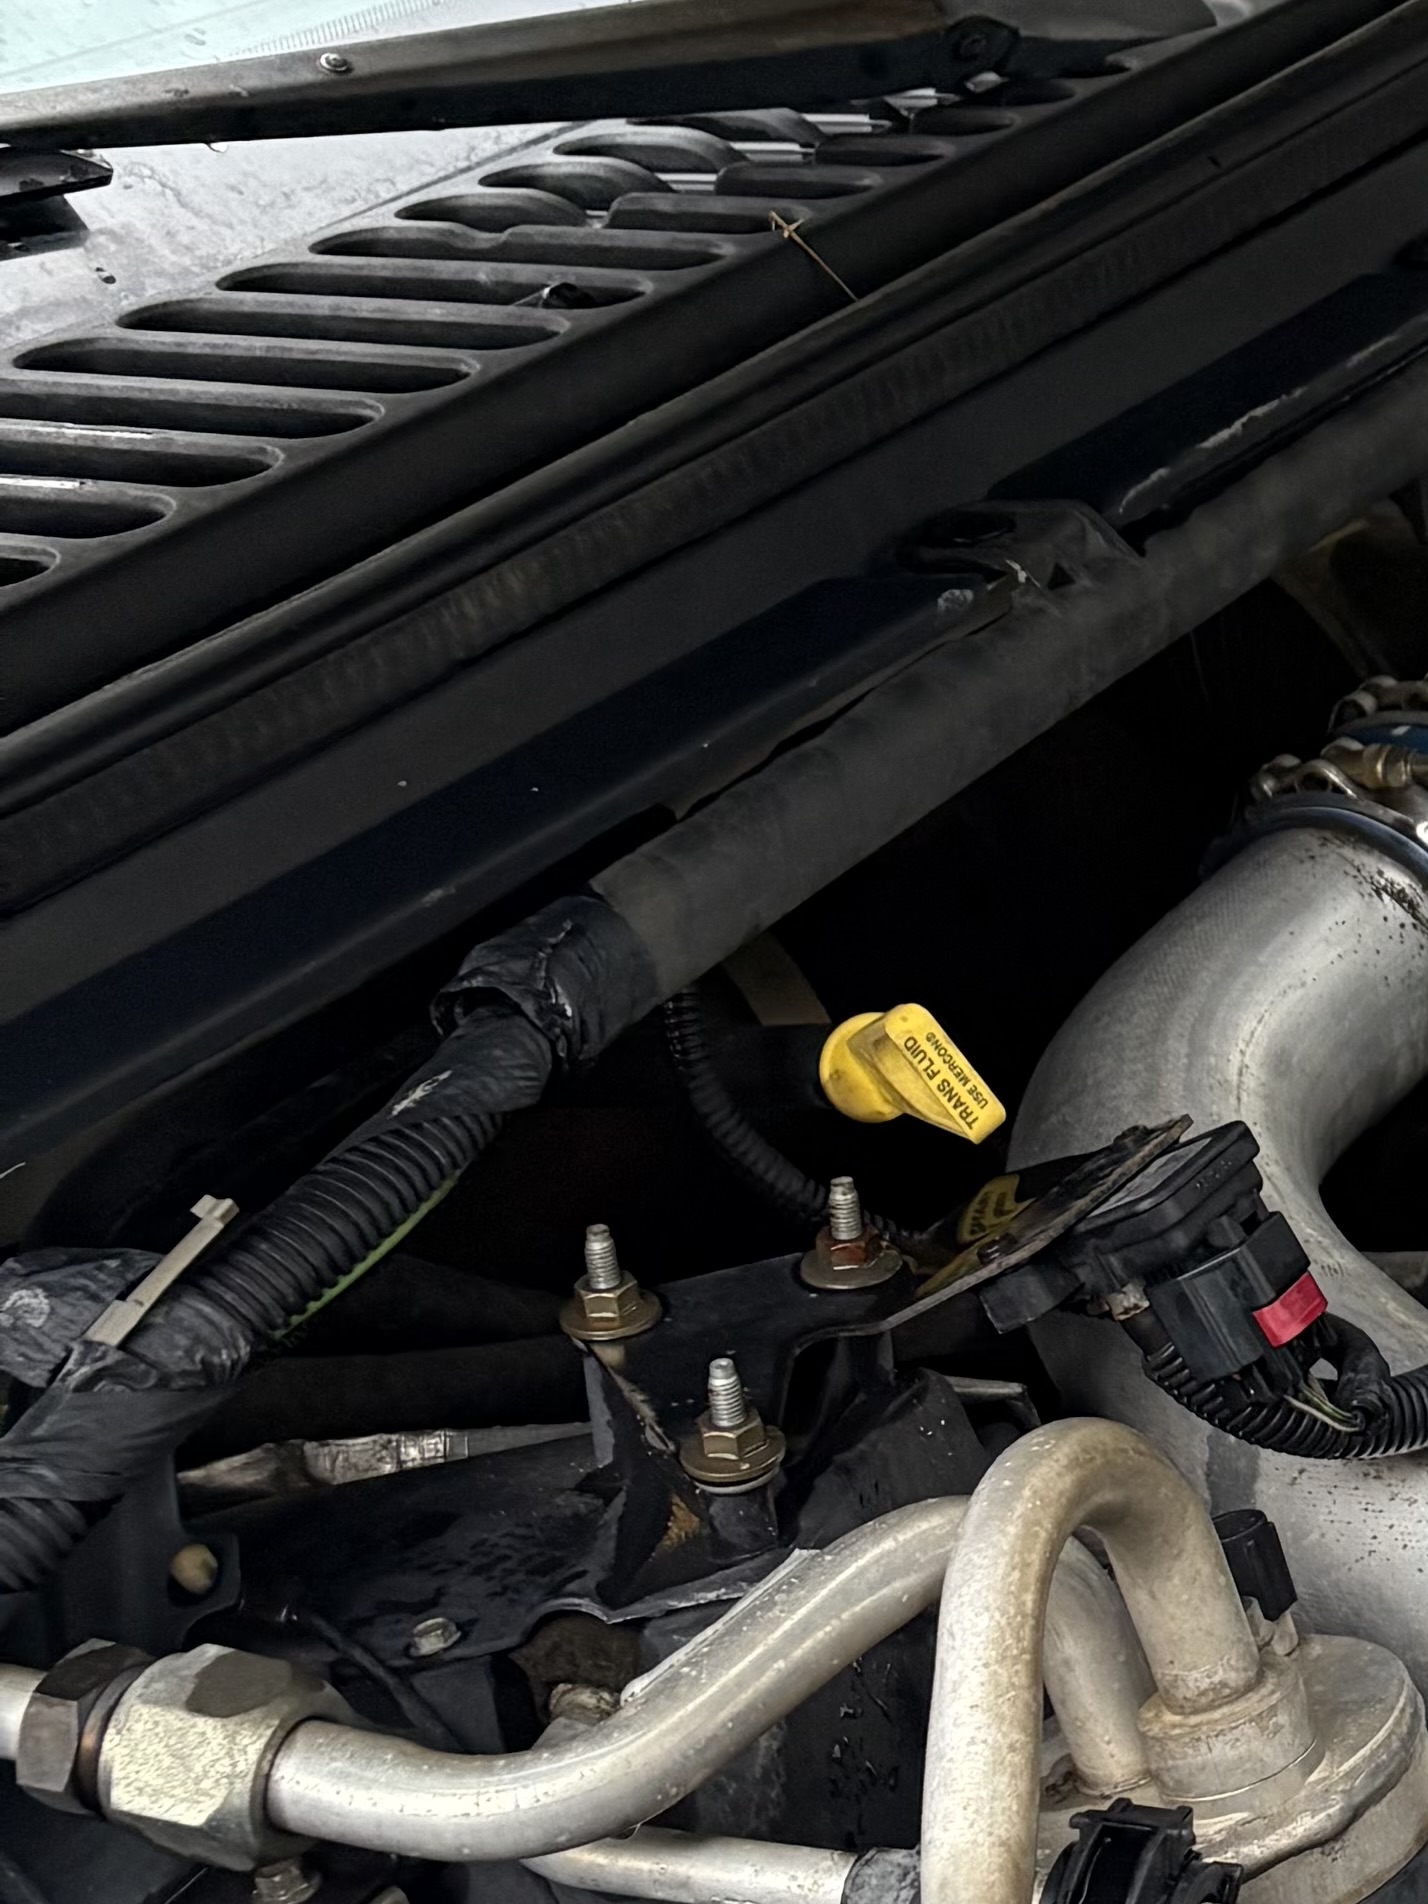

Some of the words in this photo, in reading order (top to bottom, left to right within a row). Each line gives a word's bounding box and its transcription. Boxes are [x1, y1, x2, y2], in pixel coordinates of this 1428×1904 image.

[903, 1036, 941, 1081] FLUID
[937, 1078, 979, 1130] TRANS
[966, 1084, 989, 1109] USE
